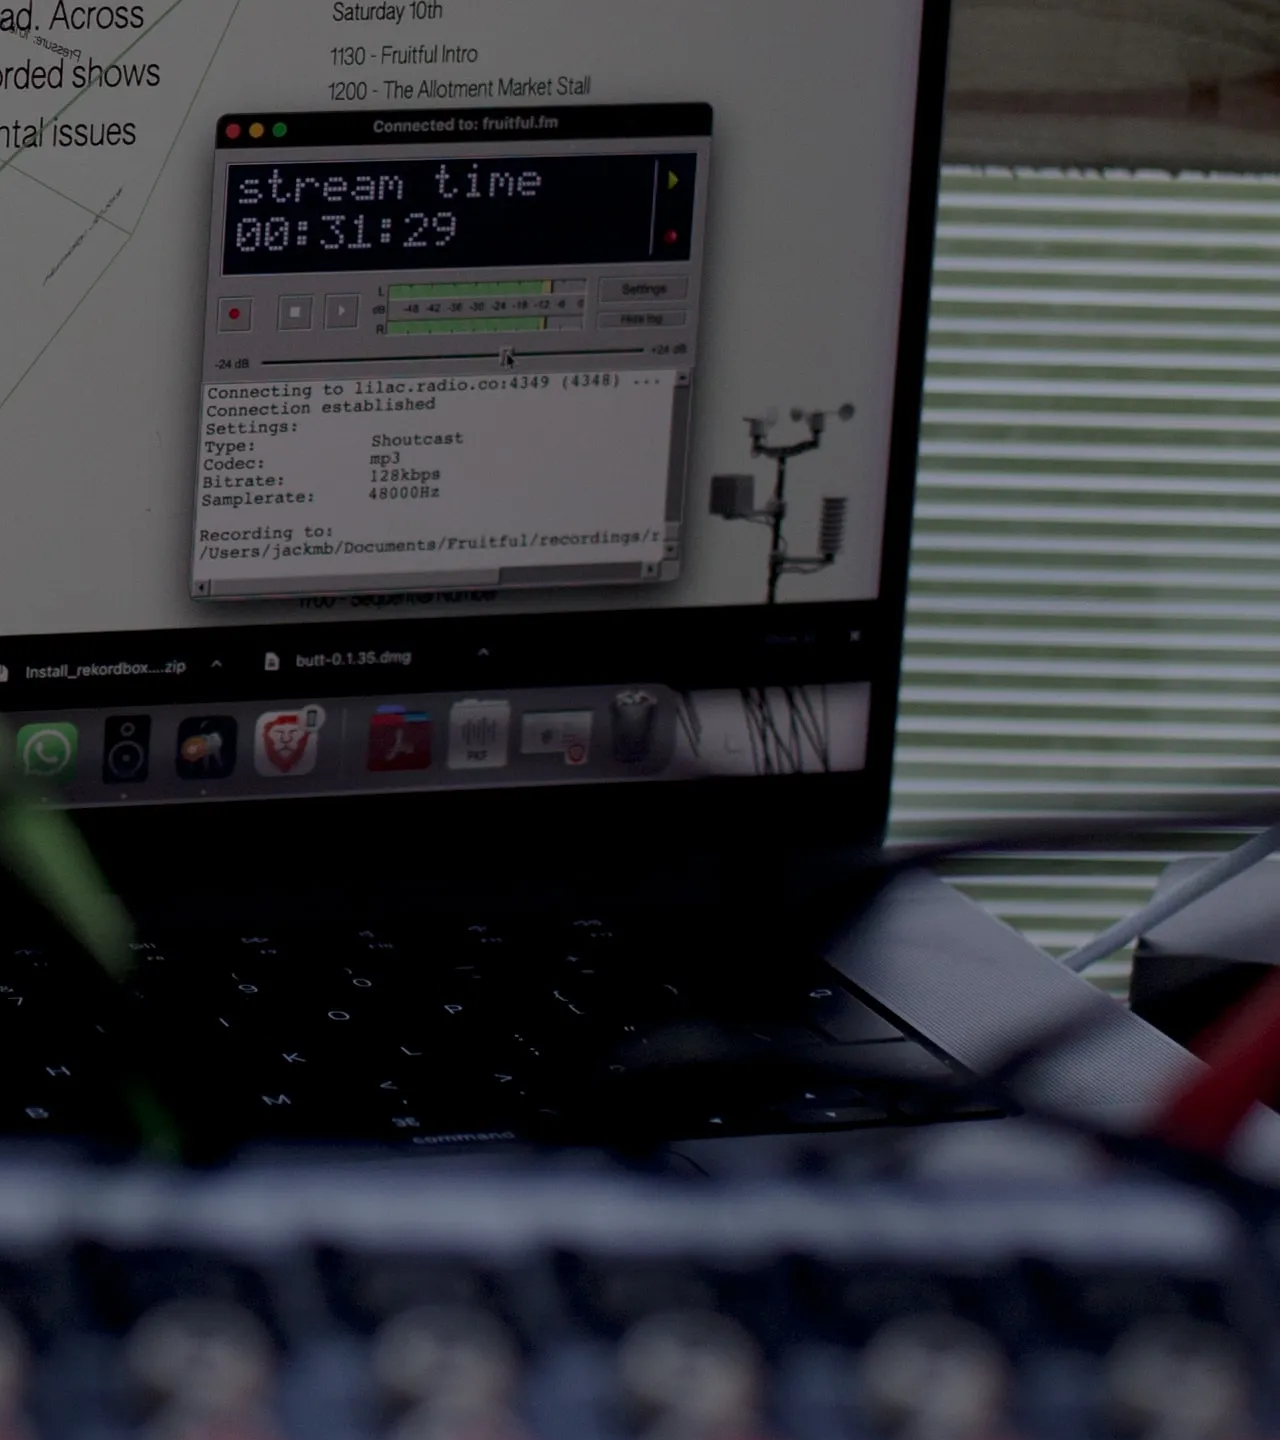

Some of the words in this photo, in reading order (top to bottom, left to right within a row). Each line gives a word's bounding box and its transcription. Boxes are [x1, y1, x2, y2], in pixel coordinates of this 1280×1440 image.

[332, 0, 406, 25] Saturday
[409, 0, 443, 20] 10th
[330, 46, 366, 66] 1130
[381, 44, 438, 65] Fruitful
[441, 44, 479, 64] Intro
[72, 55, 161, 91] shows
[328, 81, 368, 101] 1200
[383, 79, 414, 100] The
[416, 79, 494, 99] Allotment
[497, 77, 553, 97] Market
[556, 75, 591, 96] Stall
[52, 115, 137, 148] issues
[372, 117, 456, 134] Connected
[458, 118, 478, 131] to:
[482, 115, 559, 130] fruitful.fm
[238, 168, 404, 205] stream
[434, 163, 542, 199] time
[235, 211, 457, 252] 00:31:29
[378, 286, 385, 297] L
[376, 324, 385, 335] R
[215, 358, 232, 369] -24
[234, 358, 250, 369] dB
[207, 384, 312, 400] Connecting
[323, 384, 344, 395] to
[354, 376, 550, 395] lilac.radio.co:4349
[561, 373, 621, 389] (4348)
[206, 402, 310, 418] Connection
[321, 397, 436, 414] established
[205, 420, 298, 436] Settings:
[204, 440, 255, 456] Type:
[371, 432, 464, 448] Shoutcast
[203, 458, 264, 471] Codec:
[369, 452, 401, 467] mp3
[202, 475, 285, 489] Bitrate:
[370, 469, 441, 485] 128kbps
[201, 491, 314, 509] Samplerate:
[368, 486, 441, 500] 48000Hz
[199, 526, 293, 543] Recording
[304, 526, 333, 538] to:
